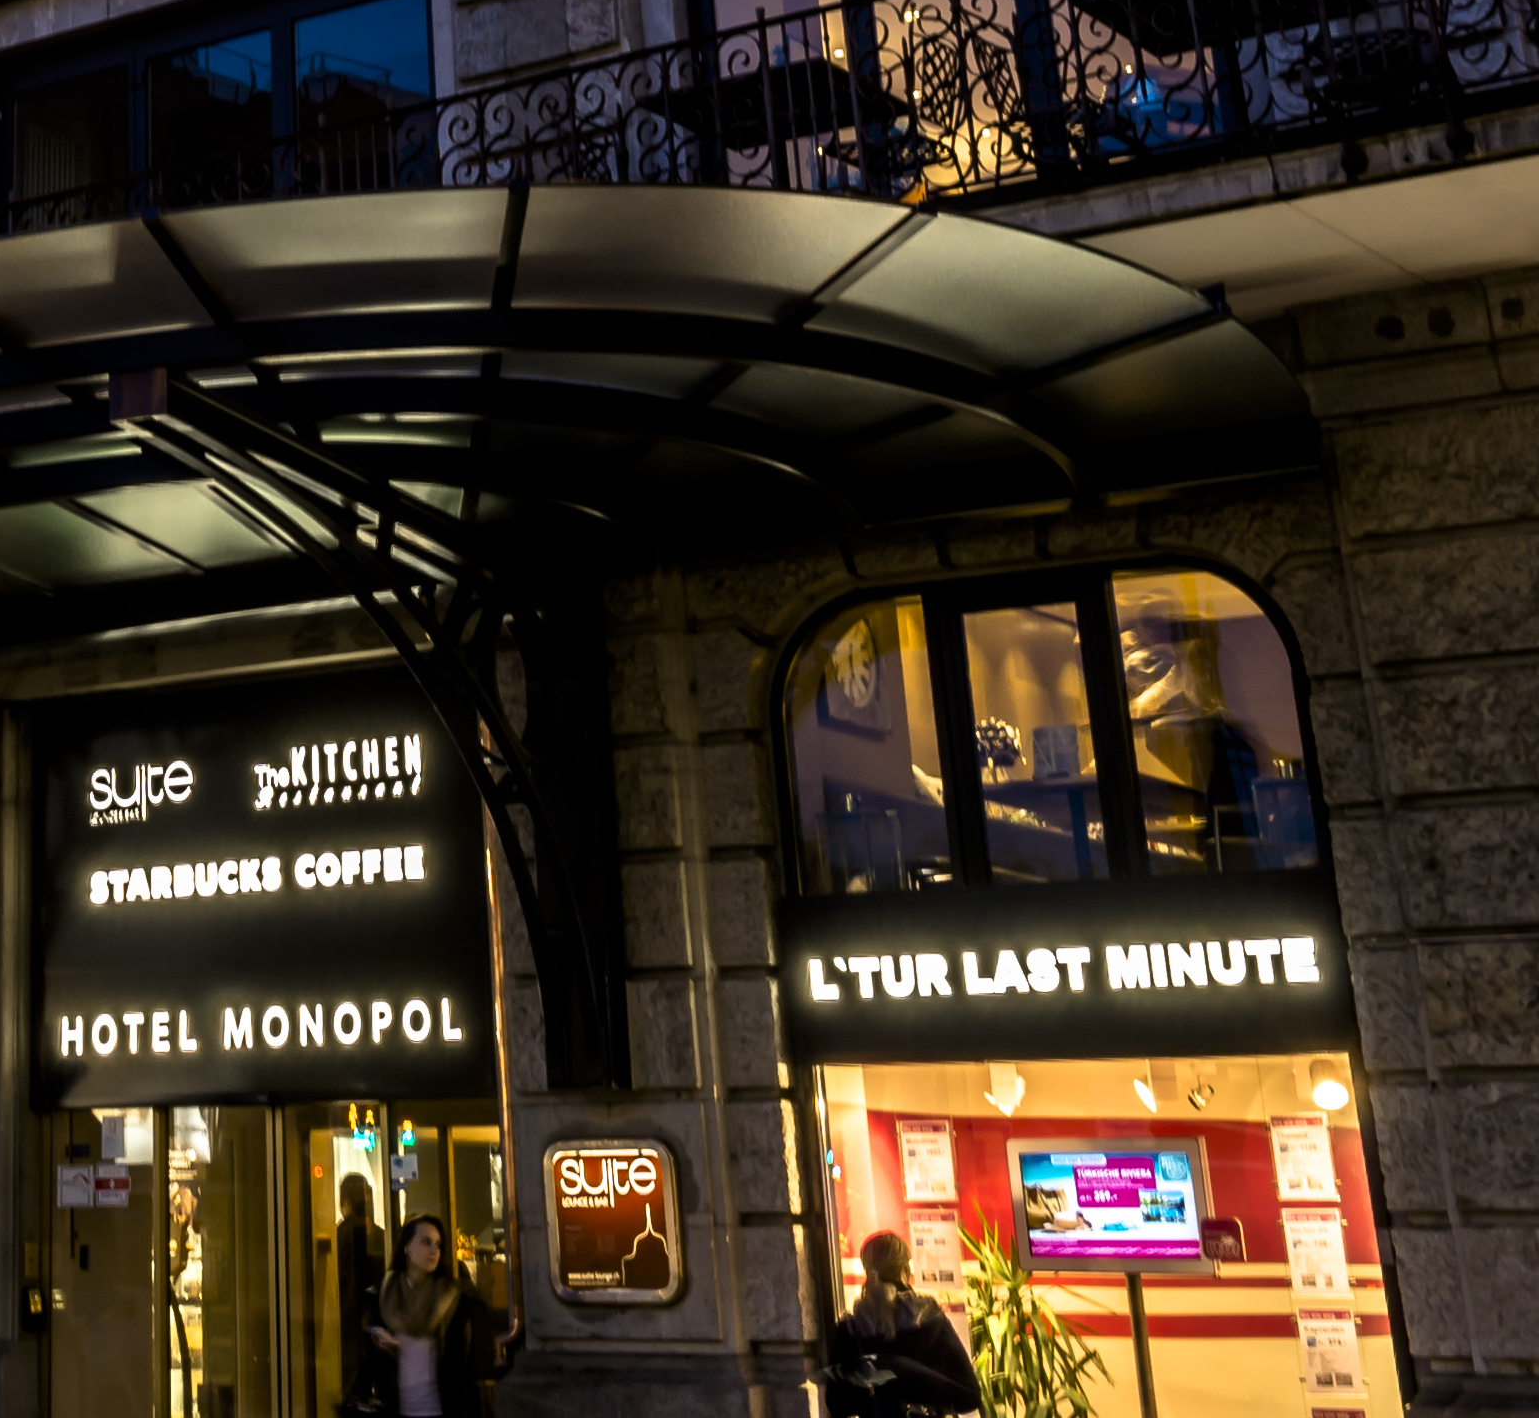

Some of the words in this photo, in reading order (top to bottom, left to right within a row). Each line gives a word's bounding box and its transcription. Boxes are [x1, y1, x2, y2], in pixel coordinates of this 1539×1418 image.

[290, 733, 422, 787] KITCHEN
[89, 855, 283, 907] STARBUCKS
[294, 845, 425, 890] COFFEE
[963, 947, 1091, 996] LAST
[1106, 936, 1320, 991] MINUTE
[60, 1009, 198, 1057] HOTEL
[223, 997, 463, 1051] MONOPOL
